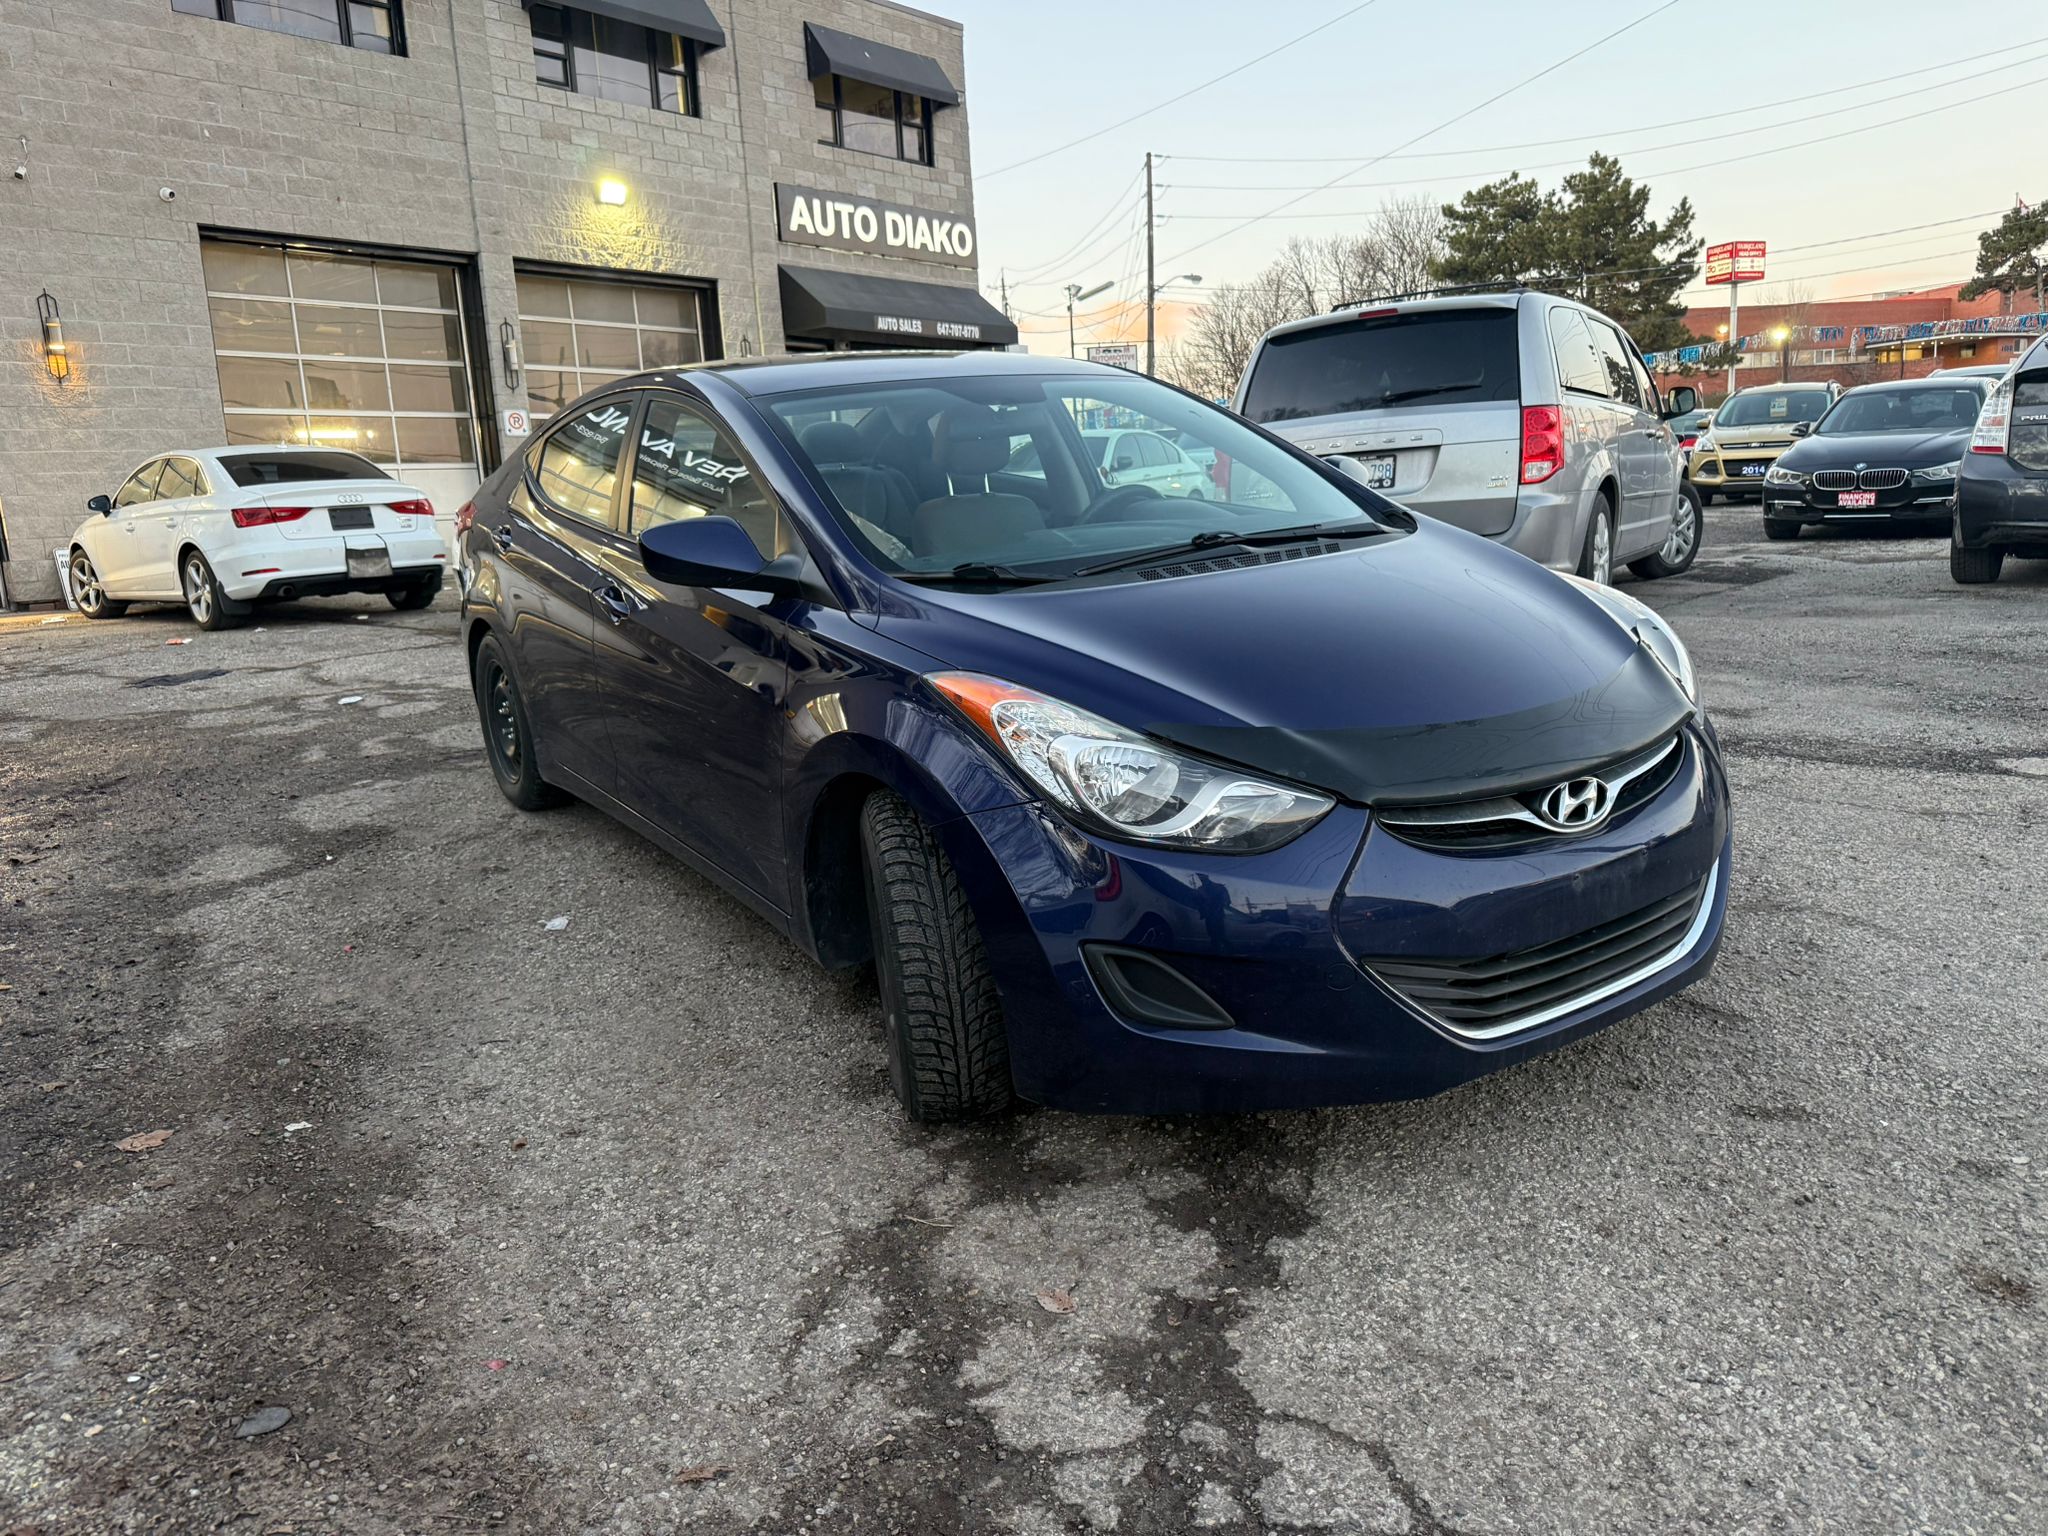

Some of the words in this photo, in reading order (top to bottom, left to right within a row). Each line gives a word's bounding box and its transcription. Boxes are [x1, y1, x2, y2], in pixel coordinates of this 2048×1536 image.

[789, 195, 878, 243] AUTO
[884, 209, 973, 257] DIAKO
[877, 316, 898, 331] AUTO
[898, 318, 923, 333] SALES
[1742, 466, 1766, 474] 2014
[1838, 492, 1876, 500] FINANCING
